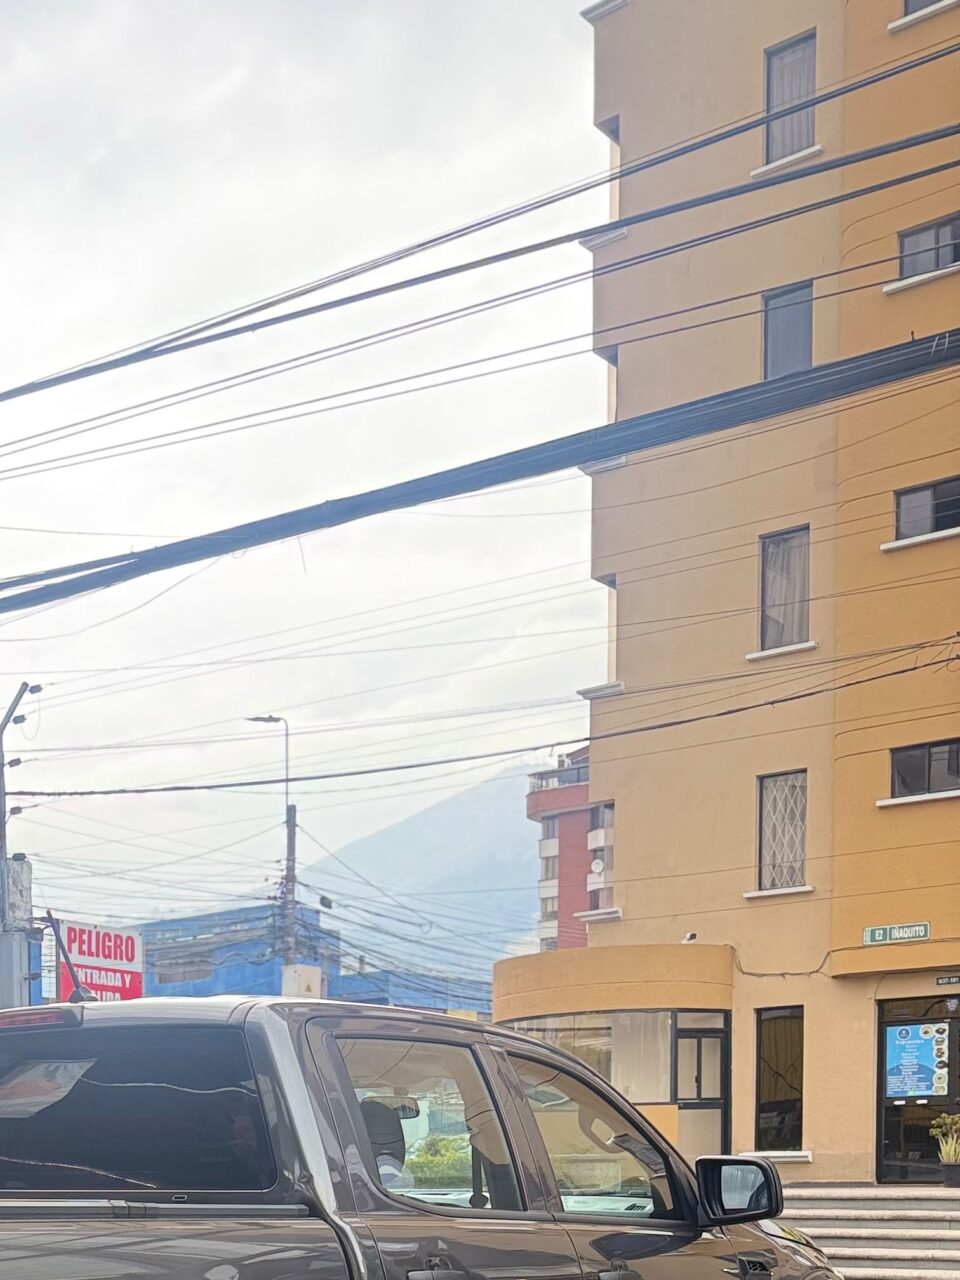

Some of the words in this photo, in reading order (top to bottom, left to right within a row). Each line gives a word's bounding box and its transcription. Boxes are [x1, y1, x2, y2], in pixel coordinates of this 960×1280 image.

[875, 930, 884, 940] E2
[891, 926, 925, 939] IÑAQUITO
[67, 926, 135, 963] PELIGRO
[124, 974, 131, 988] Y
